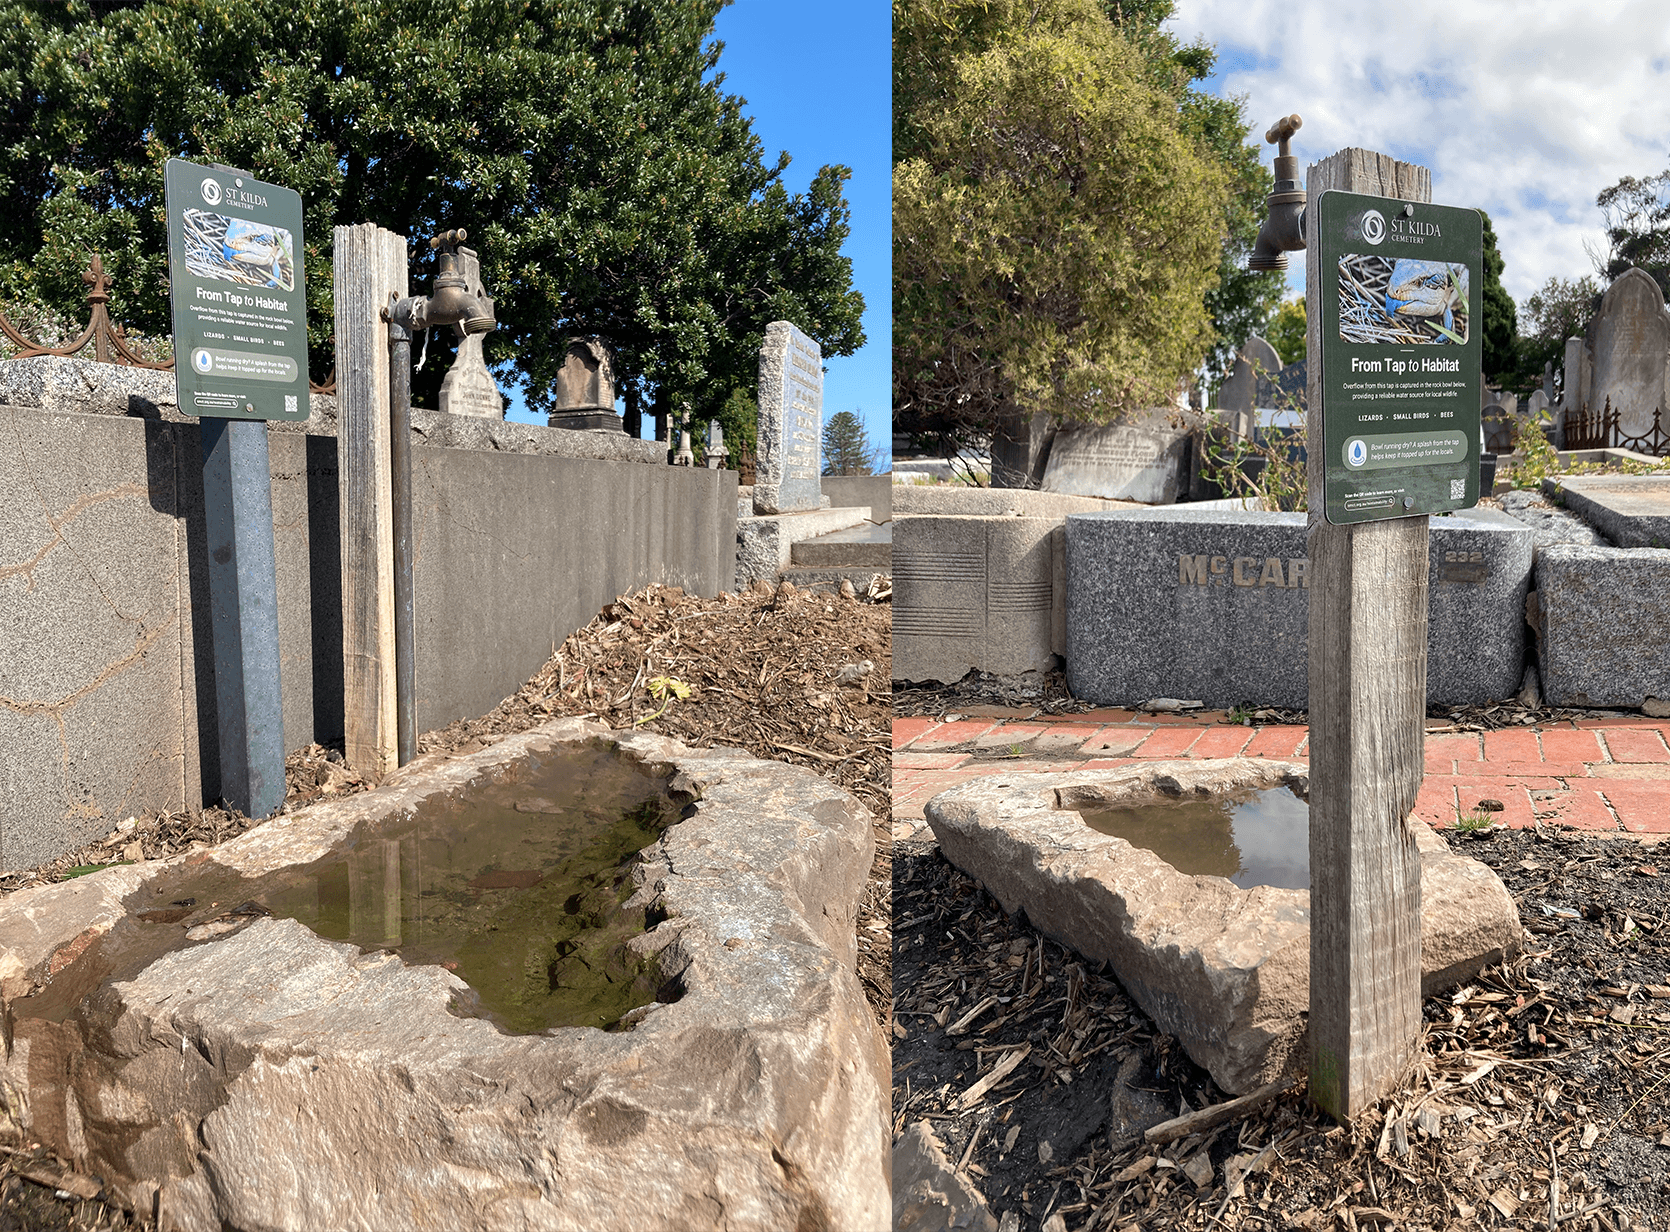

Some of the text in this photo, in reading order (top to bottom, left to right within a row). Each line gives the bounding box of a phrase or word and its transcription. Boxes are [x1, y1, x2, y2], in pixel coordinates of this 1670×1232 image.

[226, 188, 267, 207] ST KILDA
[226, 200, 254, 210] CEMETERY
[1391, 219, 1441, 237] ST KILDA
[1392, 234, 1424, 244] CEMETERY
[196, 287, 288, 311] From Tap to Habitat
[1352, 358, 1459, 375] From Tap to Habitat
[1445, 551, 1482, 562] 232
